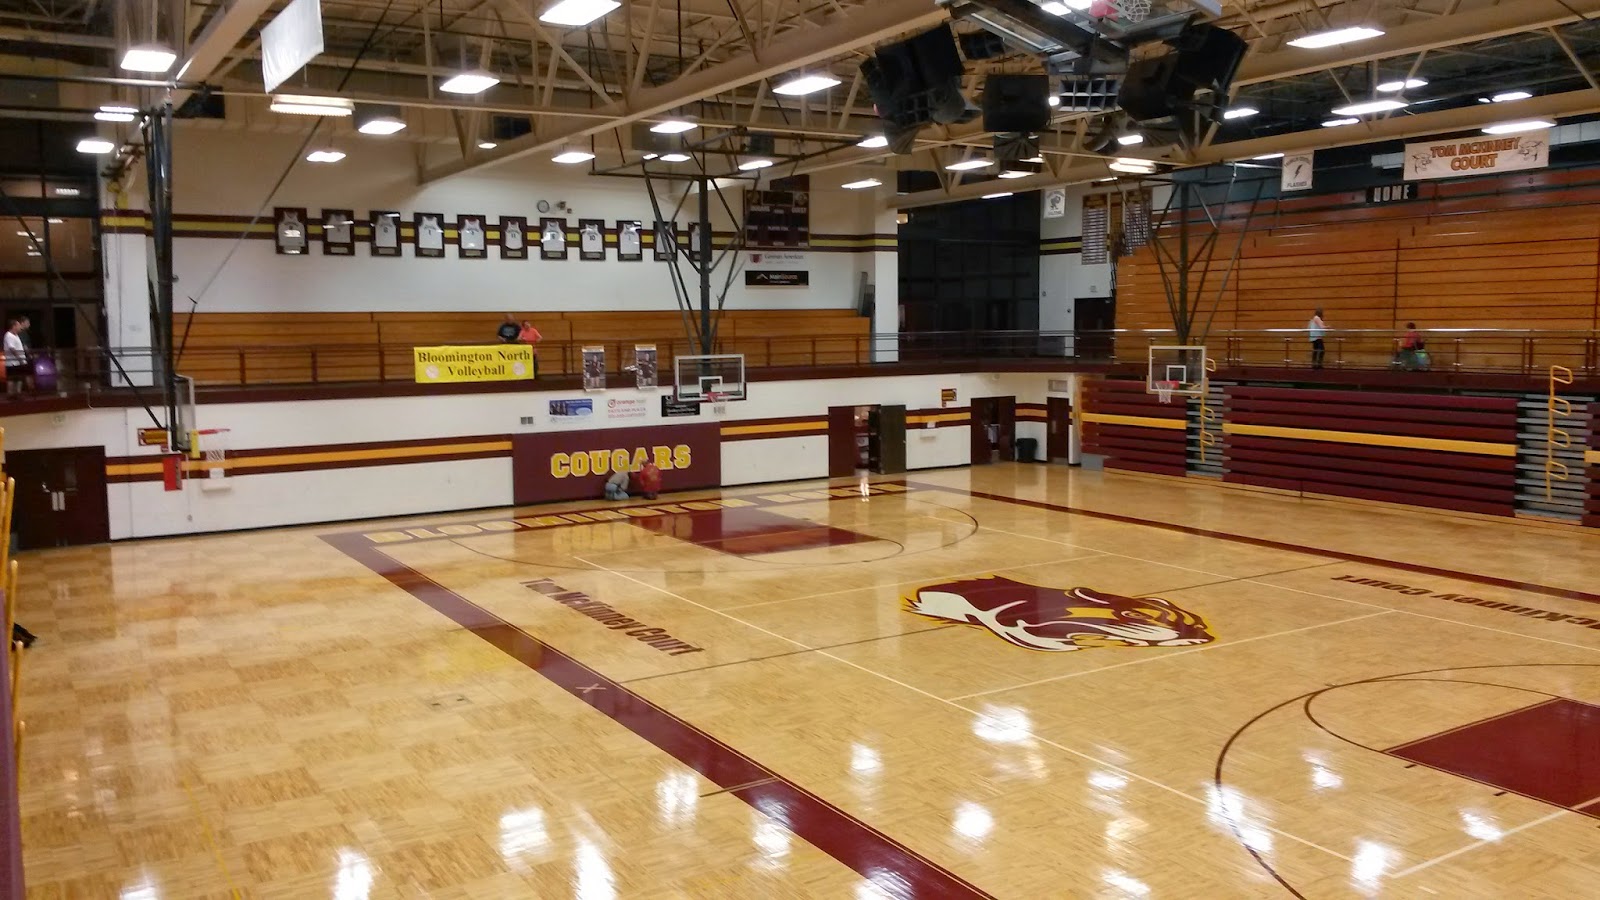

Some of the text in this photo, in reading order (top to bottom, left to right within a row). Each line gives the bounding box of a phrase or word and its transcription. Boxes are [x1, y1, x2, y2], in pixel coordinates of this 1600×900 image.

[1431, 137, 1521, 158] TOM MCKINNEY
[1450, 153, 1498, 171] COURT
[1373, 184, 1410, 203] HOME
[418, 350, 530, 364] Bloomington North
[448, 365, 505, 378] Volleyball
[551, 444, 692, 479] COUGARS
[363, 499, 759, 543] BLOOMINGTON
[1330, 574, 1433, 596] Court
[625, 627, 705, 656] Court
